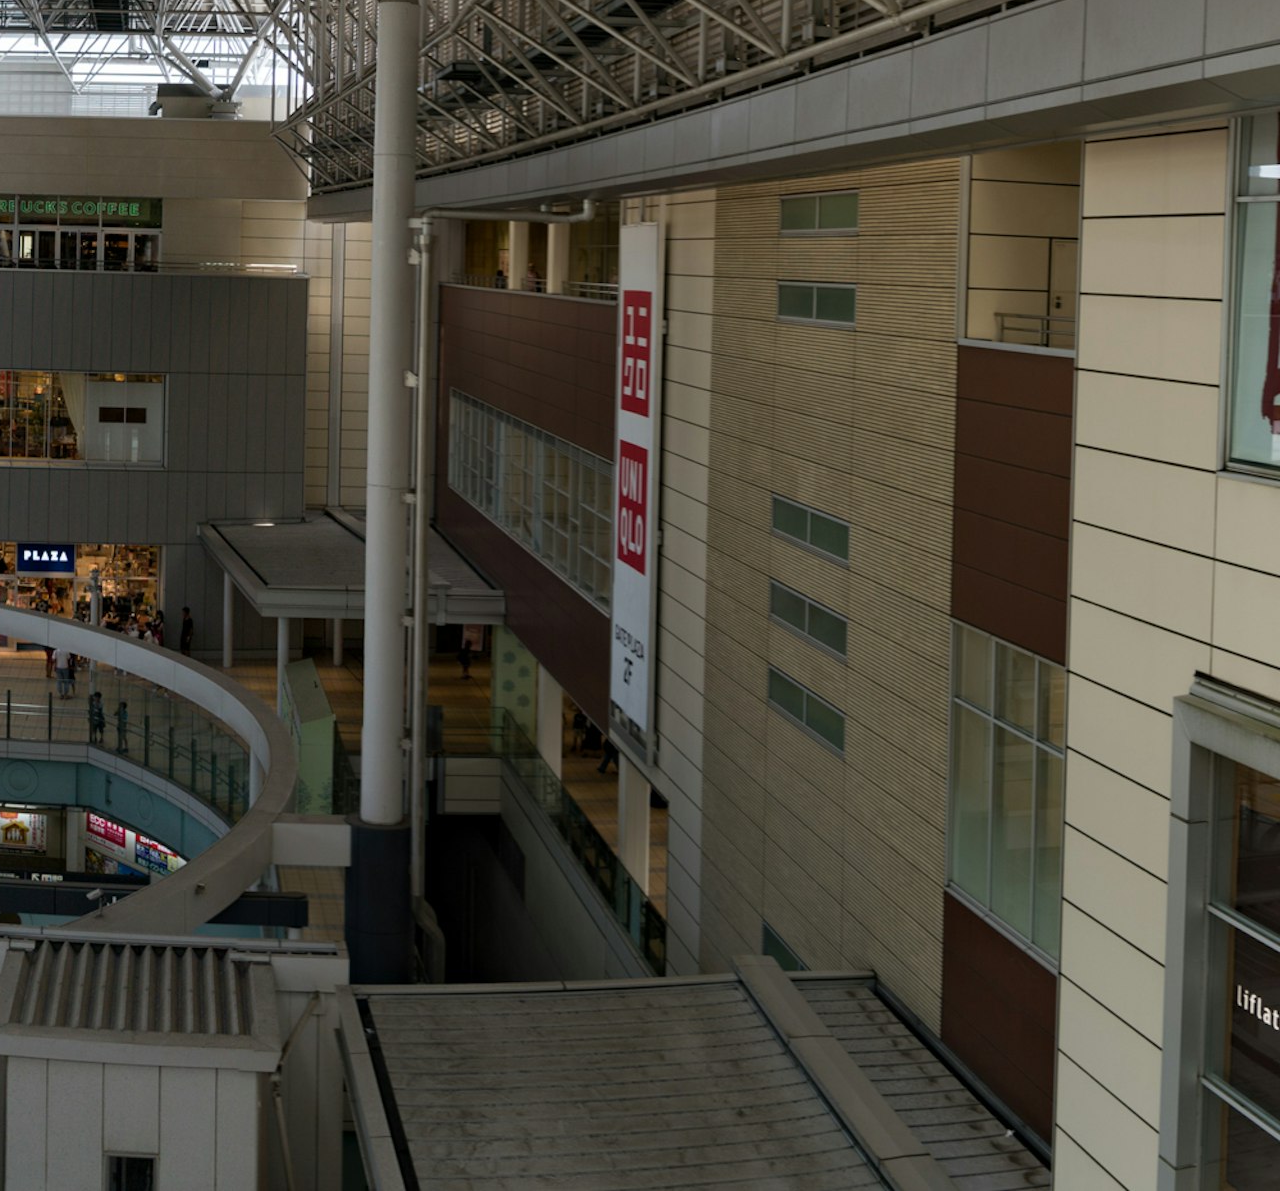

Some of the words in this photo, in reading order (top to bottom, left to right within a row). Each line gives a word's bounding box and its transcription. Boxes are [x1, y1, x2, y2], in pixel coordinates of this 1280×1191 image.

[71, 200, 140, 216] COFFEE
[625, 305, 648, 347] ユニ
[623, 357, 647, 400] クロ
[621, 455, 643, 504] UNI
[620, 507, 644, 556] QLO
[23, 549, 69, 562] PLAZA
